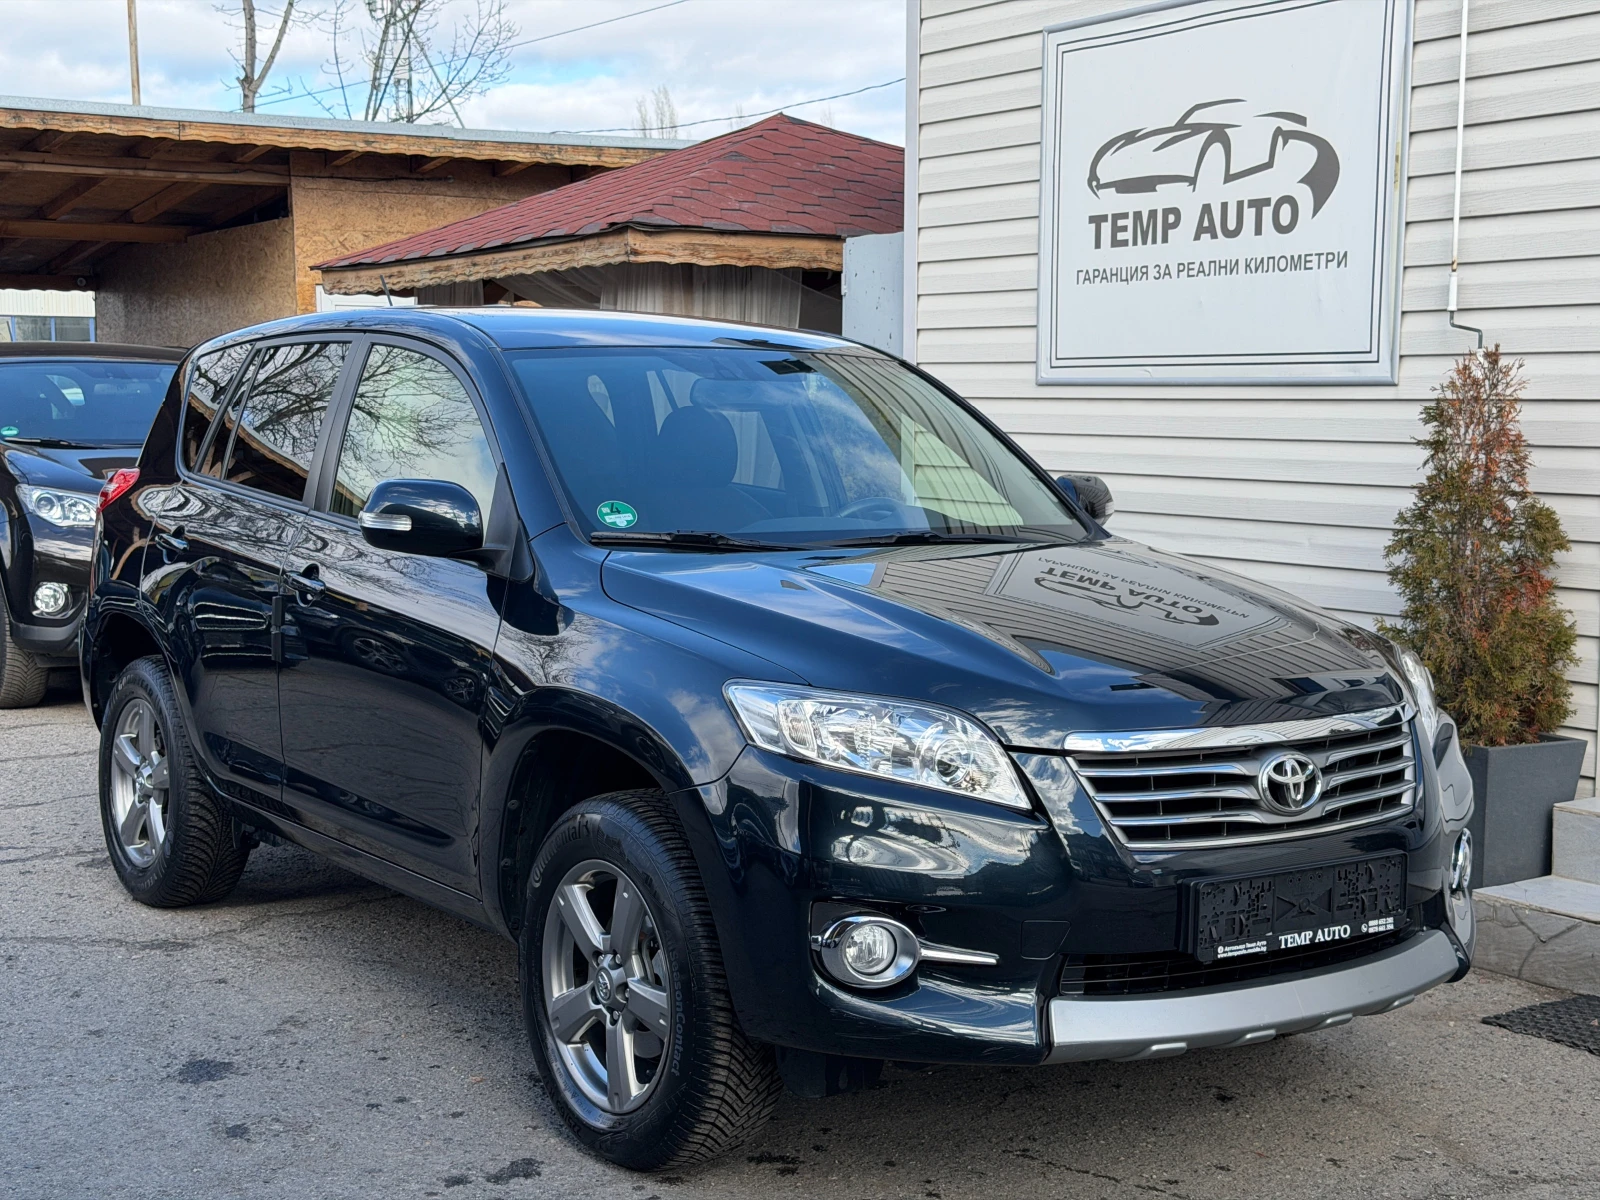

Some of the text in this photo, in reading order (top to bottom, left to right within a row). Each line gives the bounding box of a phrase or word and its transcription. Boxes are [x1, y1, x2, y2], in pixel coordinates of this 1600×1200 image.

[1088, 194, 1299, 250] TEMP AUTO
[1076, 250, 1348, 285] ГАРАНЦИЯ ЗА РЕАЛНИ КИЛОМЕТРИ
[610, 502, 621, 514] 4
[1279, 924, 1351, 949] TEMP AUTO
